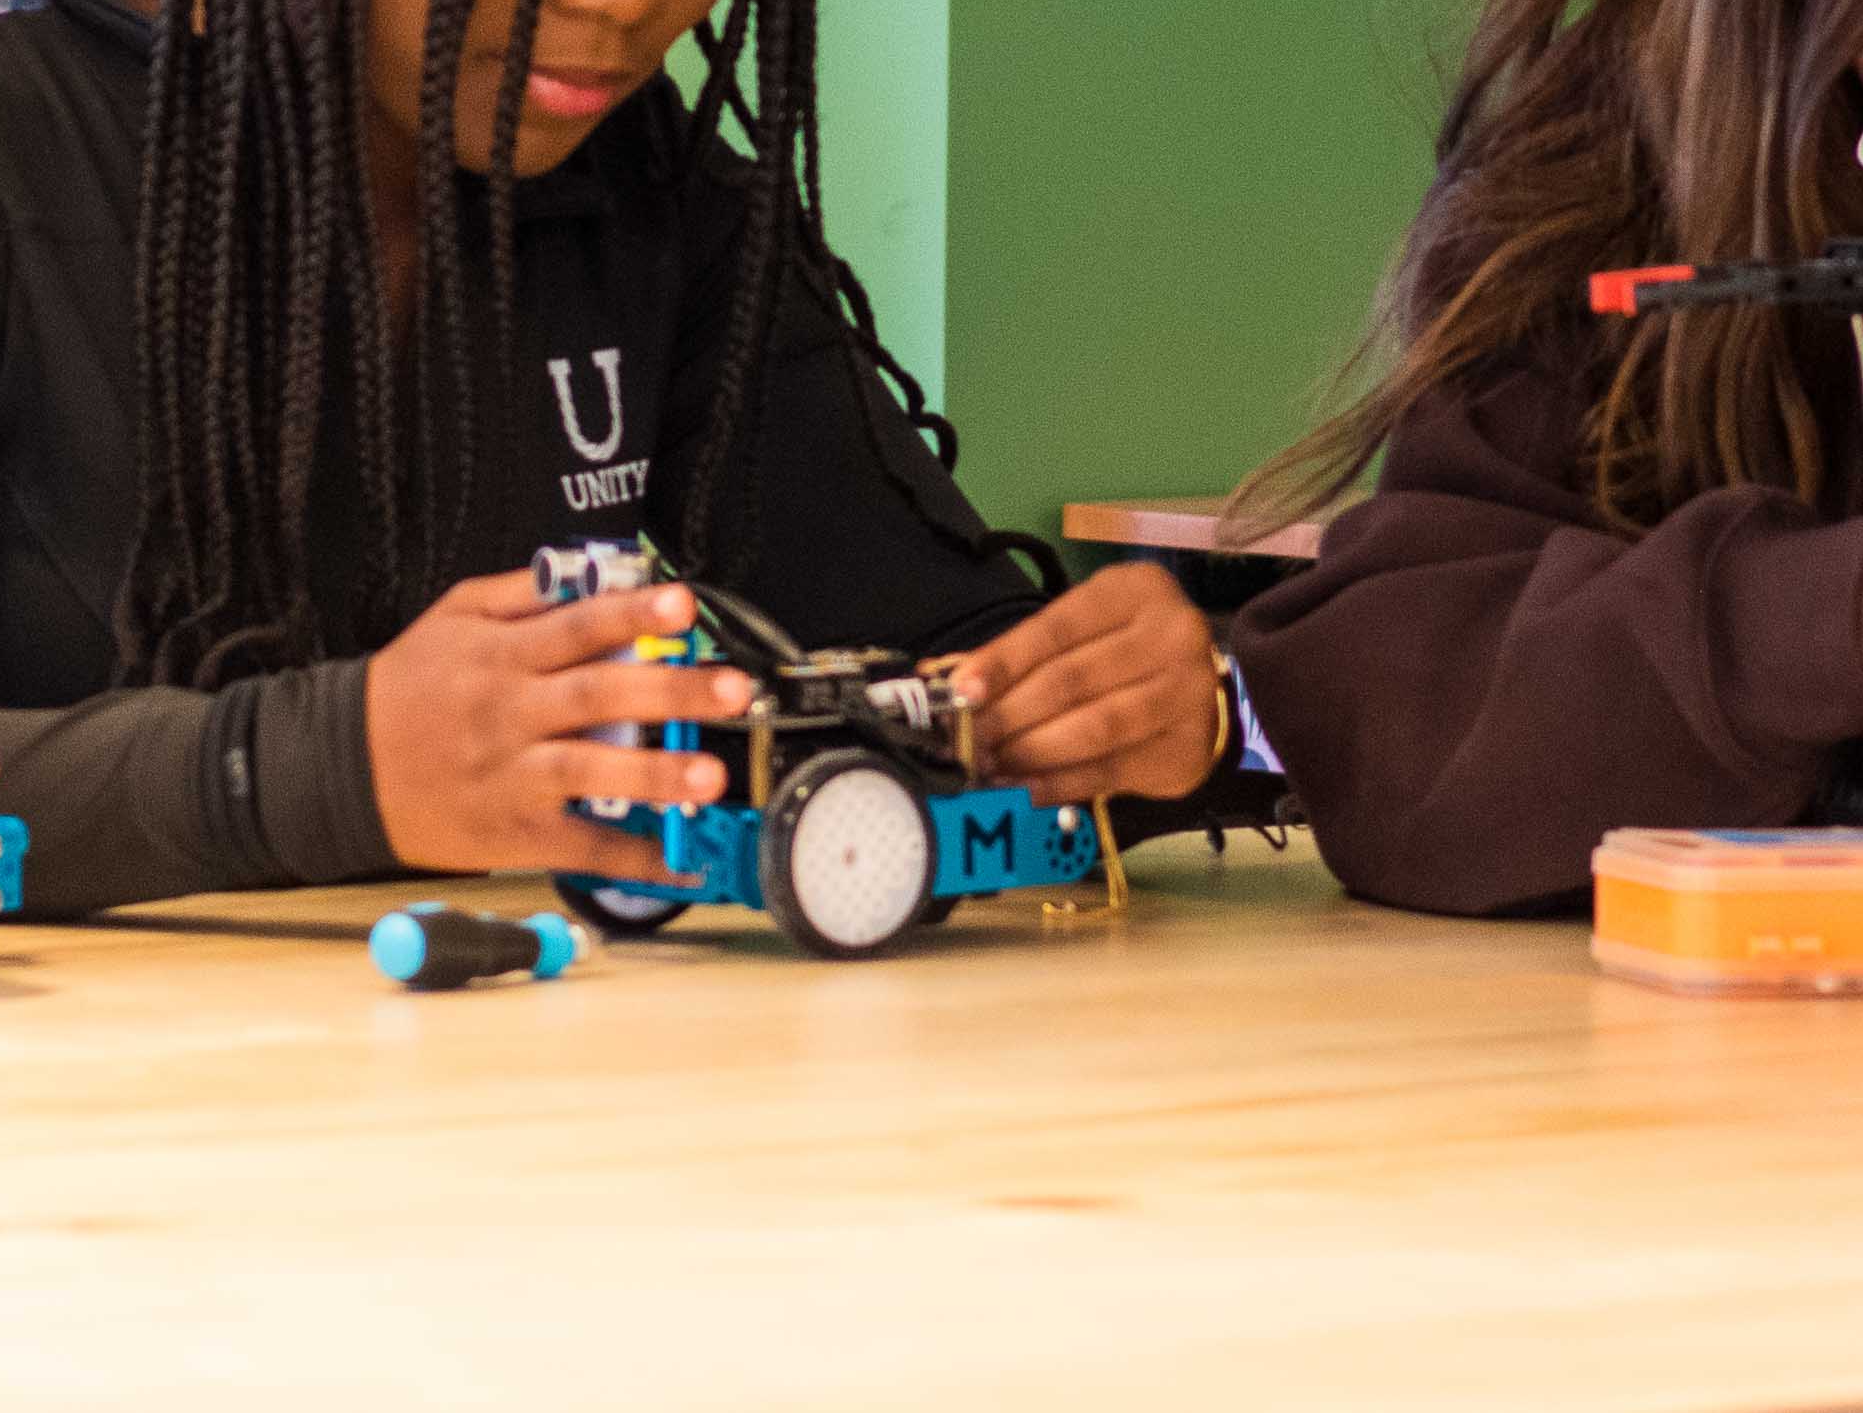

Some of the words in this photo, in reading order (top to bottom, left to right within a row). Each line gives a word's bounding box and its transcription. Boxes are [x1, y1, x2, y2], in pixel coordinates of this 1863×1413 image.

[546, 347, 624, 462] U
[560, 458, 650, 512] UNITY
[962, 810, 1015, 876] M
